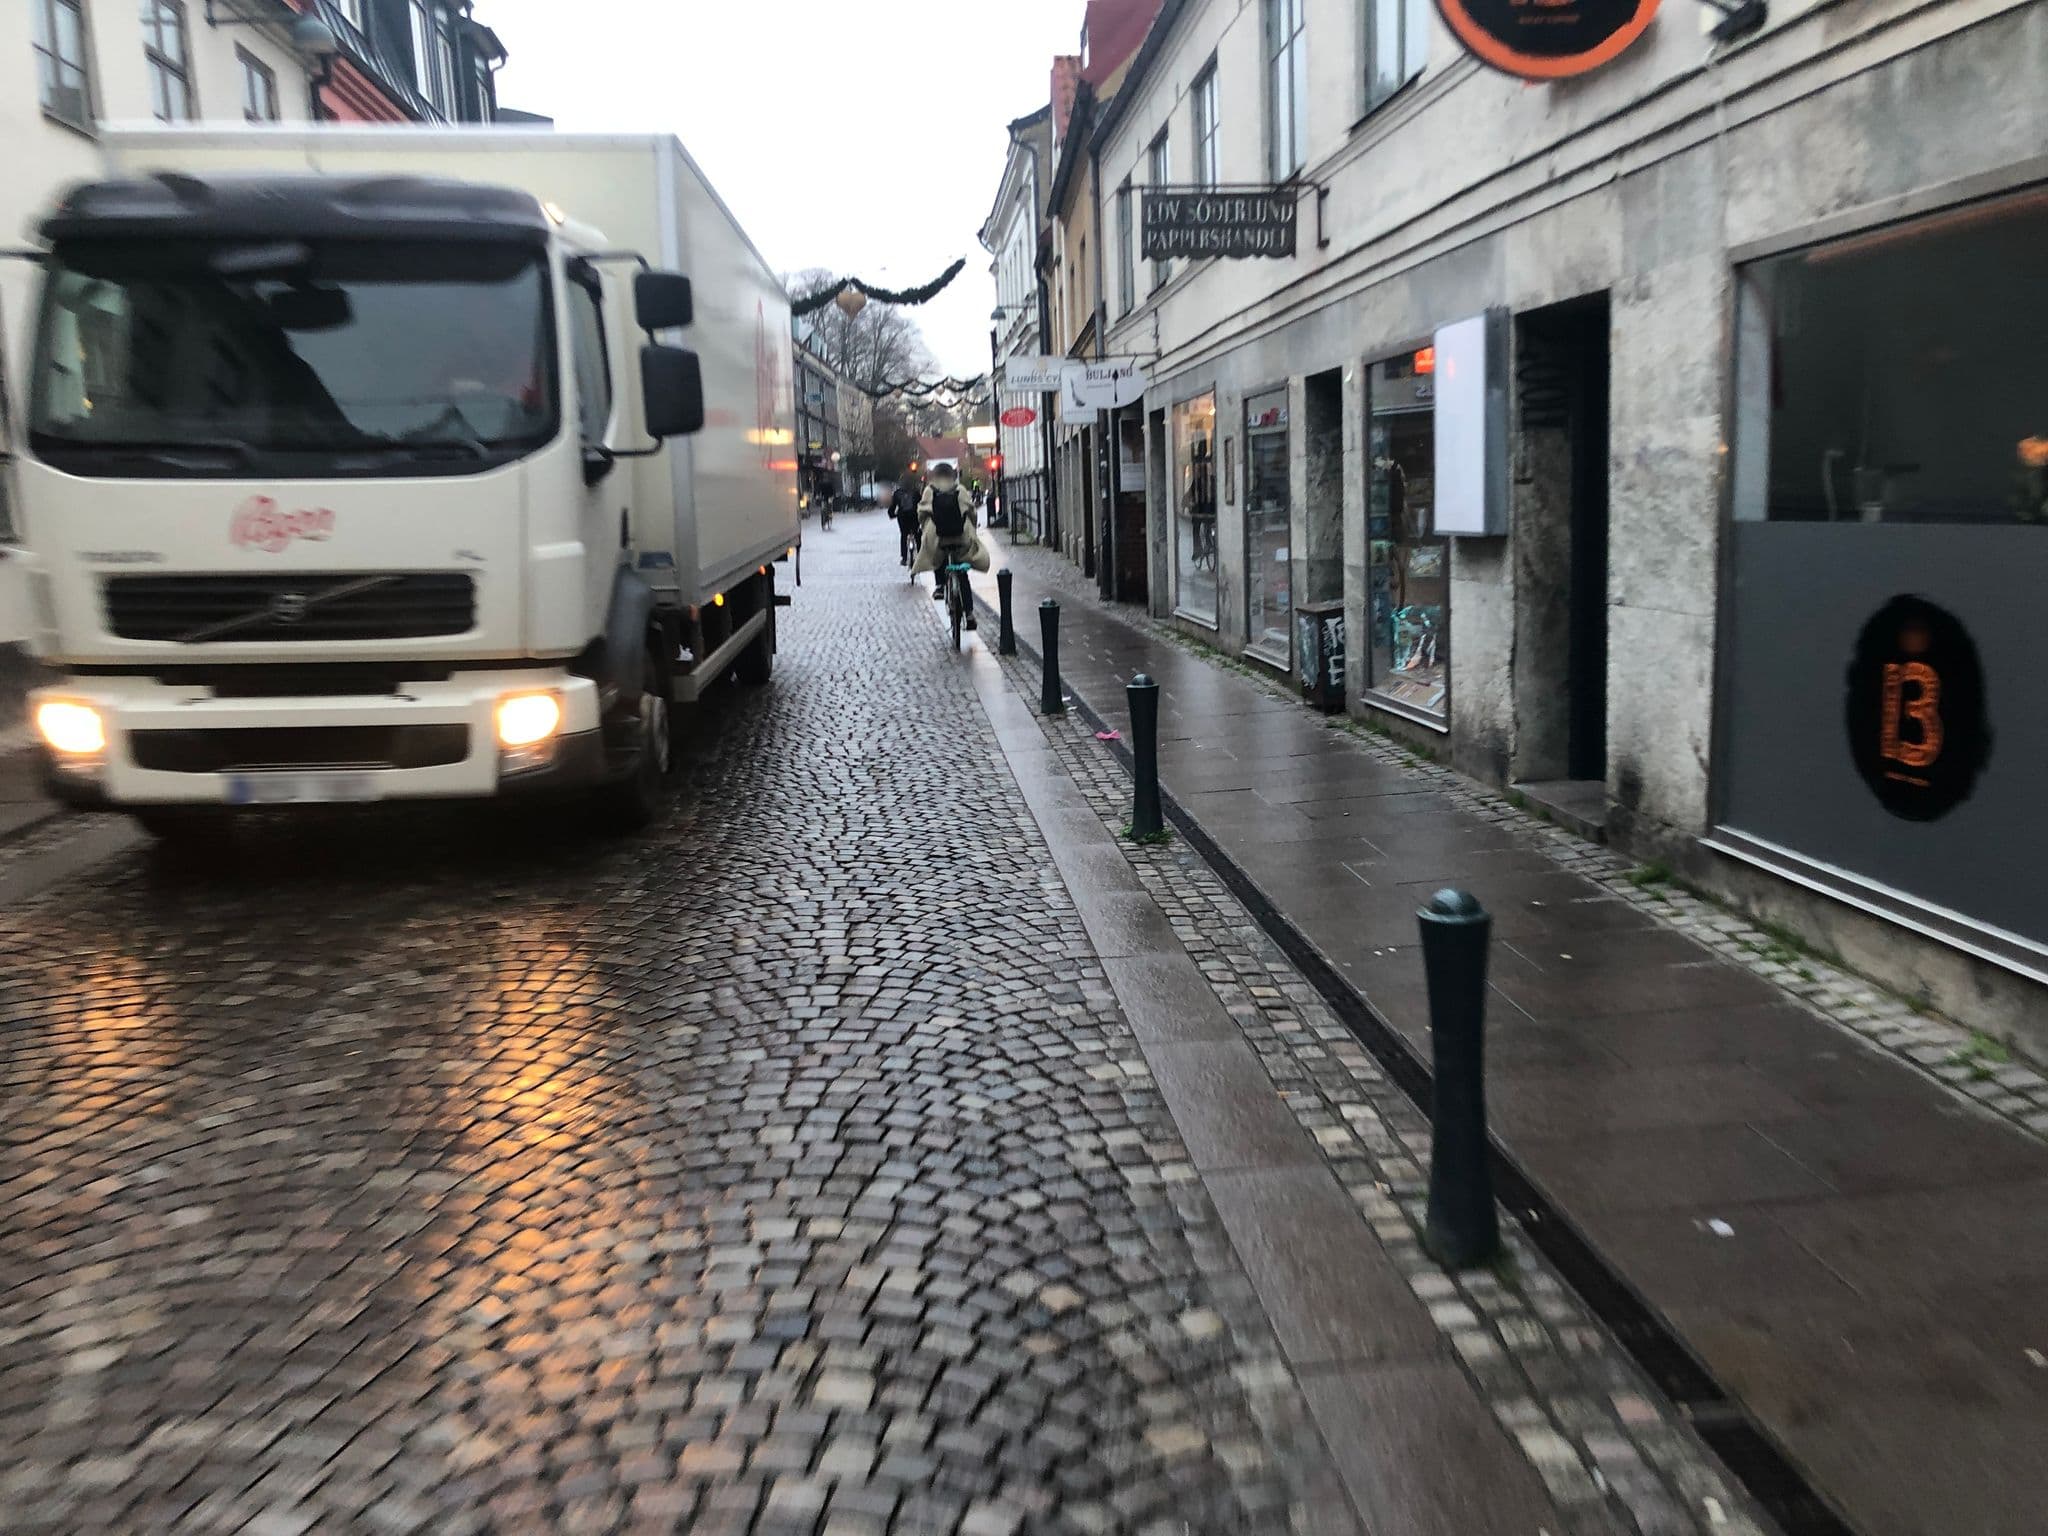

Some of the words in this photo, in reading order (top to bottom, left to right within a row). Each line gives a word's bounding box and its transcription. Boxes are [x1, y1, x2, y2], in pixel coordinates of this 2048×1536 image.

[1187, 197, 1293, 223] SÖDERLUND
[1146, 227, 1287, 250] PAPPERSHANDEL
[1880, 661, 1944, 767] B
